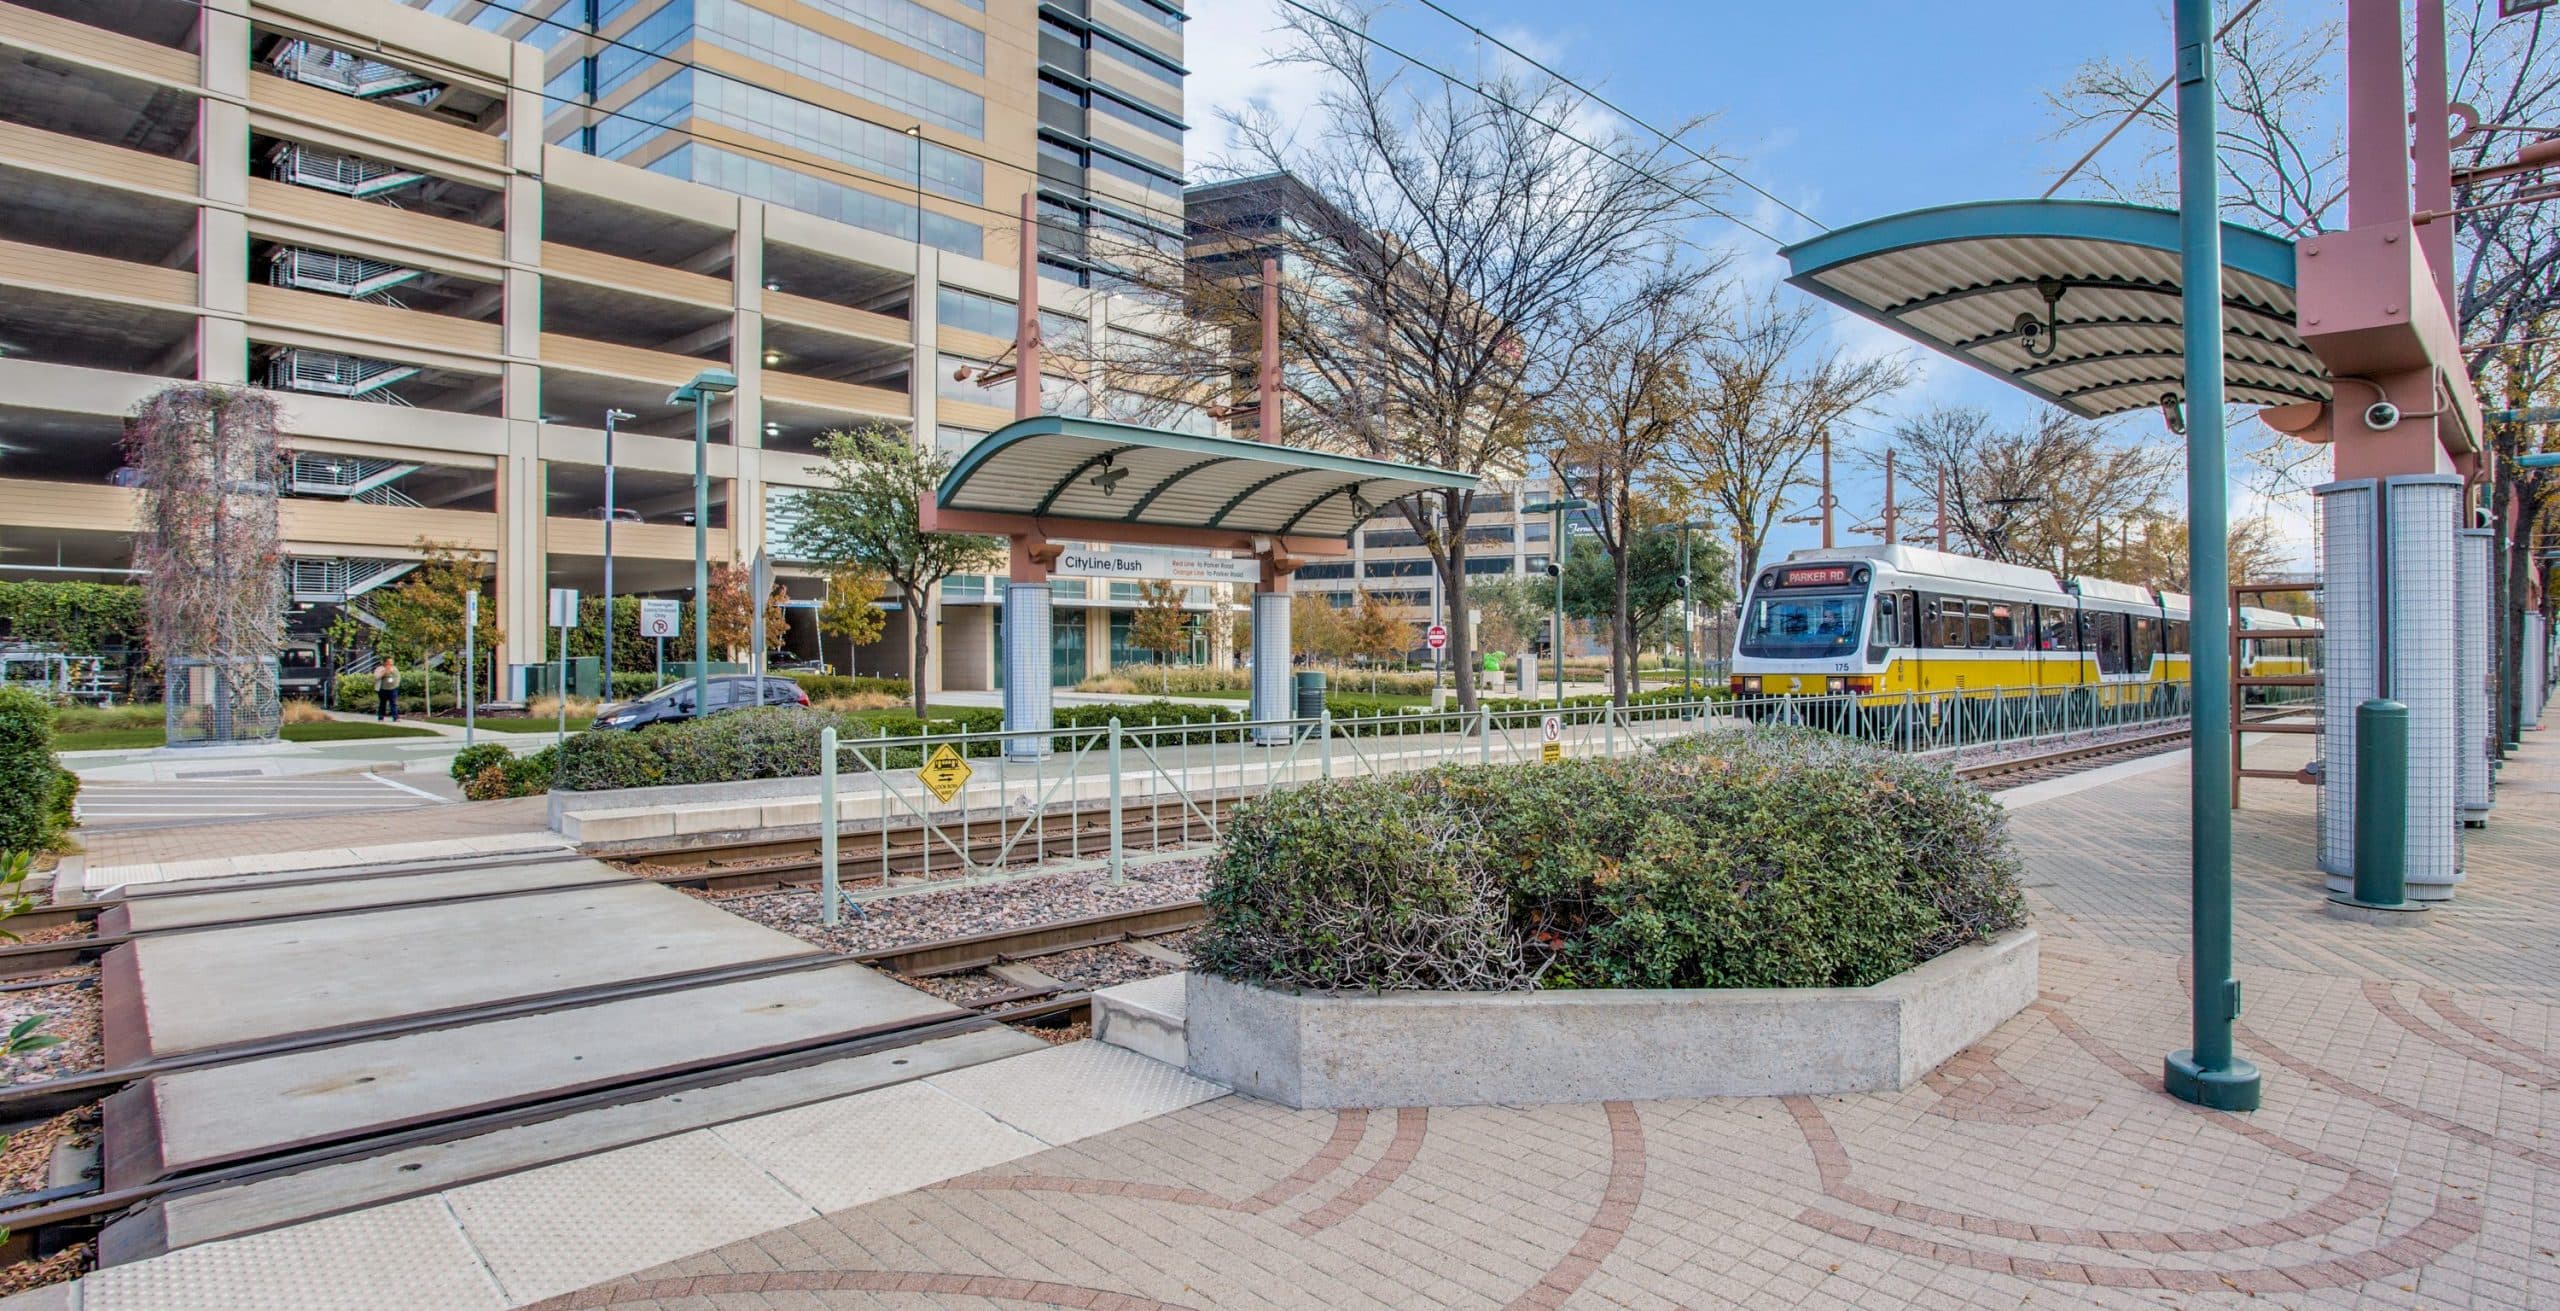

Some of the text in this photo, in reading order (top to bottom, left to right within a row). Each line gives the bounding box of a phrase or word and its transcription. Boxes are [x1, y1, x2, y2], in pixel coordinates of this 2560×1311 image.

[1065, 556, 1142, 571] CityLine/Bush
[1790, 570, 1844, 582] PARKER RD
[1835, 663, 1850, 672] 175
